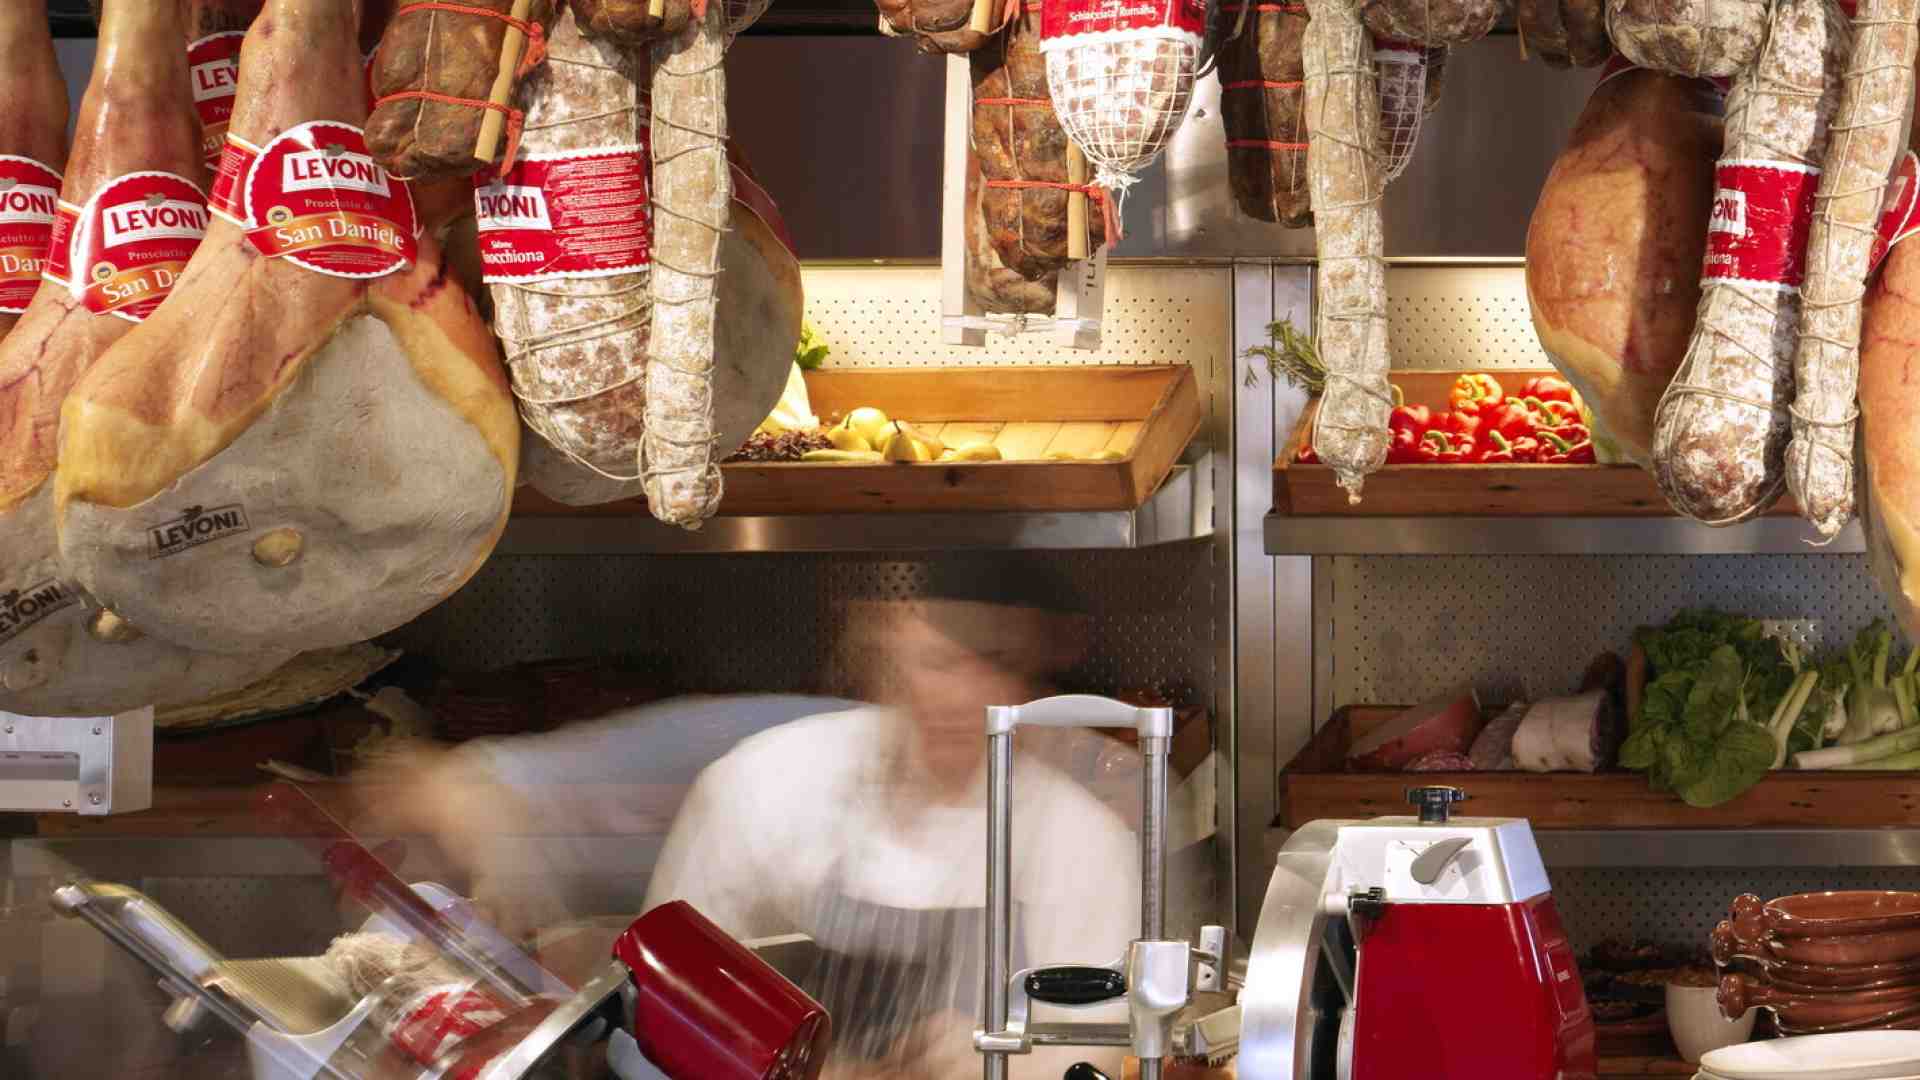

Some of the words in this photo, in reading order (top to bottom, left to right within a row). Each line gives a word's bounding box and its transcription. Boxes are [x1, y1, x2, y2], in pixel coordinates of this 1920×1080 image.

[291, 157, 382, 187] LEVONI
[110, 207, 205, 234] LEVONI
[276, 224, 323, 247] San
[329, 217, 405, 250] Daniele
[102, 277, 150, 303] San
[153, 511, 239, 549] LEVONI
